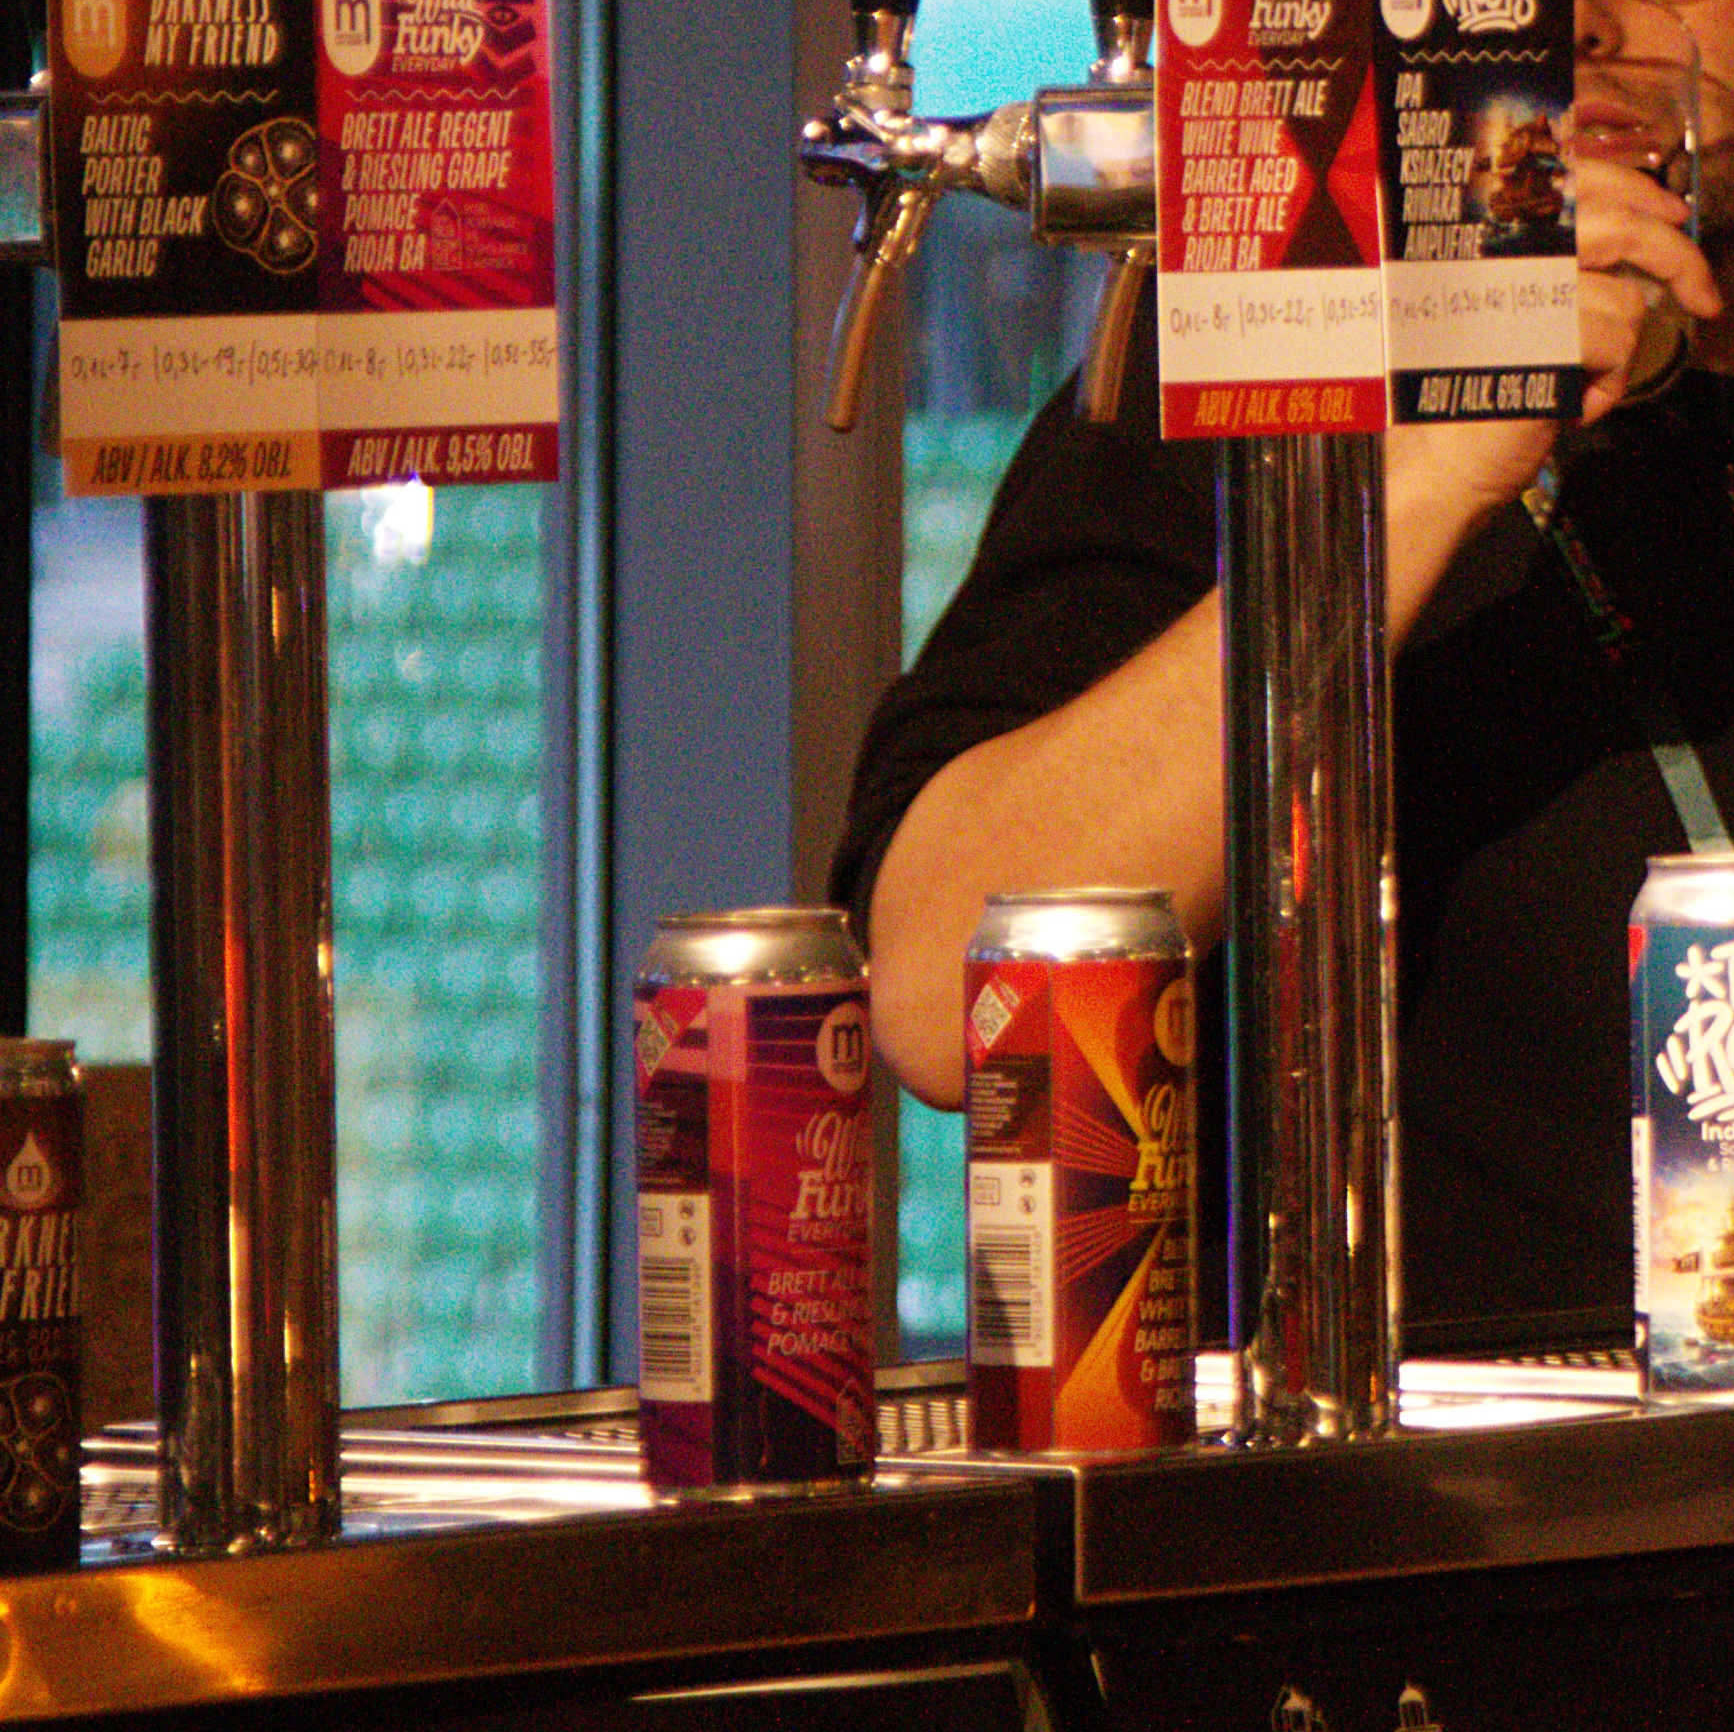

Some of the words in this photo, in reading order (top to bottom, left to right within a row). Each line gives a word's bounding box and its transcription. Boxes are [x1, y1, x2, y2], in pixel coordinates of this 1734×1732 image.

[144, 24, 184, 67] MY
[187, 23, 279, 66] FRIEND
[391, 8, 486, 66] Funky
[391, 56, 461, 74] EVERYDAY
[1180, 79, 1237, 117] BLEND
[1238, 79, 1294, 116] BRETT
[1293, 79, 1329, 116] ALE
[1395, 72, 1424, 109] IPA
[80, 114, 152, 154] BALTIC
[340, 110, 398, 150] BRETT
[400, 109, 434, 149] ALE
[437, 108, 514, 148] REGENT
[1181, 118, 1237, 156] WHITE
[1238, 119, 1284, 155] WINE
[1397, 111, 1452, 147] SABRO
[81, 155, 163, 196] PORTER
[341, 153, 355, 192] &
[358, 151, 443, 191] RIESLING
[446, 150, 512, 189] GRAPE
[1181, 157, 1248, 195] BARREL
[1249, 156, 1299, 194] AGED
[84, 196, 138, 236] WITH
[140, 196, 210, 236] BLACK
[343, 192, 419, 231] POMACE
[1181, 197, 1198, 234] &
[1199, 196, 1254, 233] BRETT
[1254, 196, 1290, 233] ALE
[85, 238, 160, 278] GARLIC
[344, 232, 397, 273] RIOJA
[399, 232, 427, 272] BA
[1183, 235, 1233, 272] RIOJA
[1235, 235, 1263, 271] BA
[1193, 390, 1233, 427] ABV
[1417, 374, 1451, 413] ABV
[92, 445, 136, 486] ABV
[150, 442, 192, 484] ALK.
[347, 437, 391, 477] ABV
[401, 434, 441, 475] ALK.
[767, 1269, 830, 1295] BRETT
